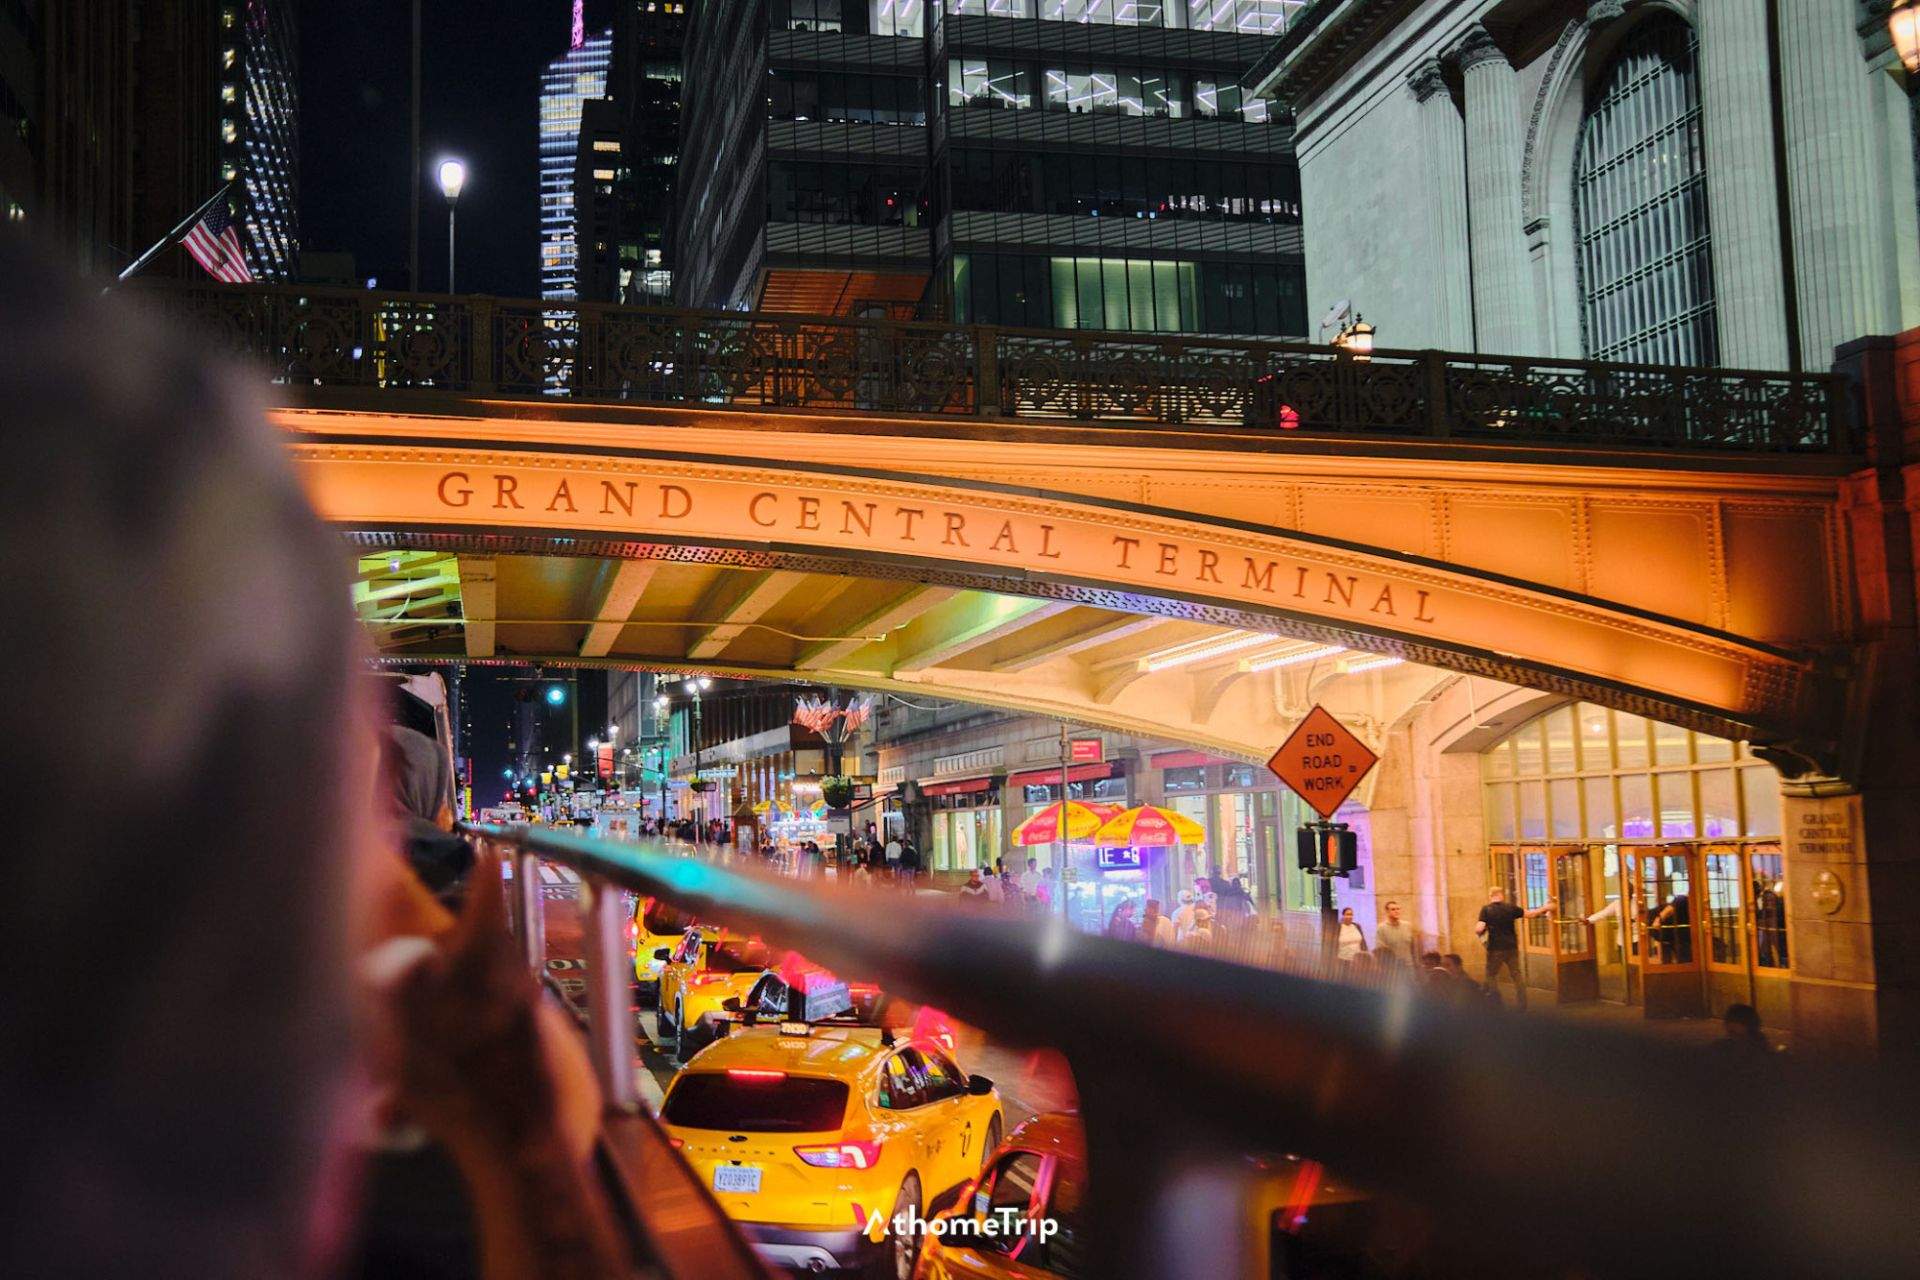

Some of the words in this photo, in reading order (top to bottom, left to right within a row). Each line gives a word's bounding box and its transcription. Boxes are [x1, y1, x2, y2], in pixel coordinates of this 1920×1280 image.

[437, 471, 693, 519] GRAND
[749, 492, 1061, 558] CENTRAL
[1112, 536, 1435, 624] TERMINAL
[1306, 733, 1335, 747] END
[1302, 755, 1342, 769] ROAD
[1304, 776, 1345, 791] WORK
